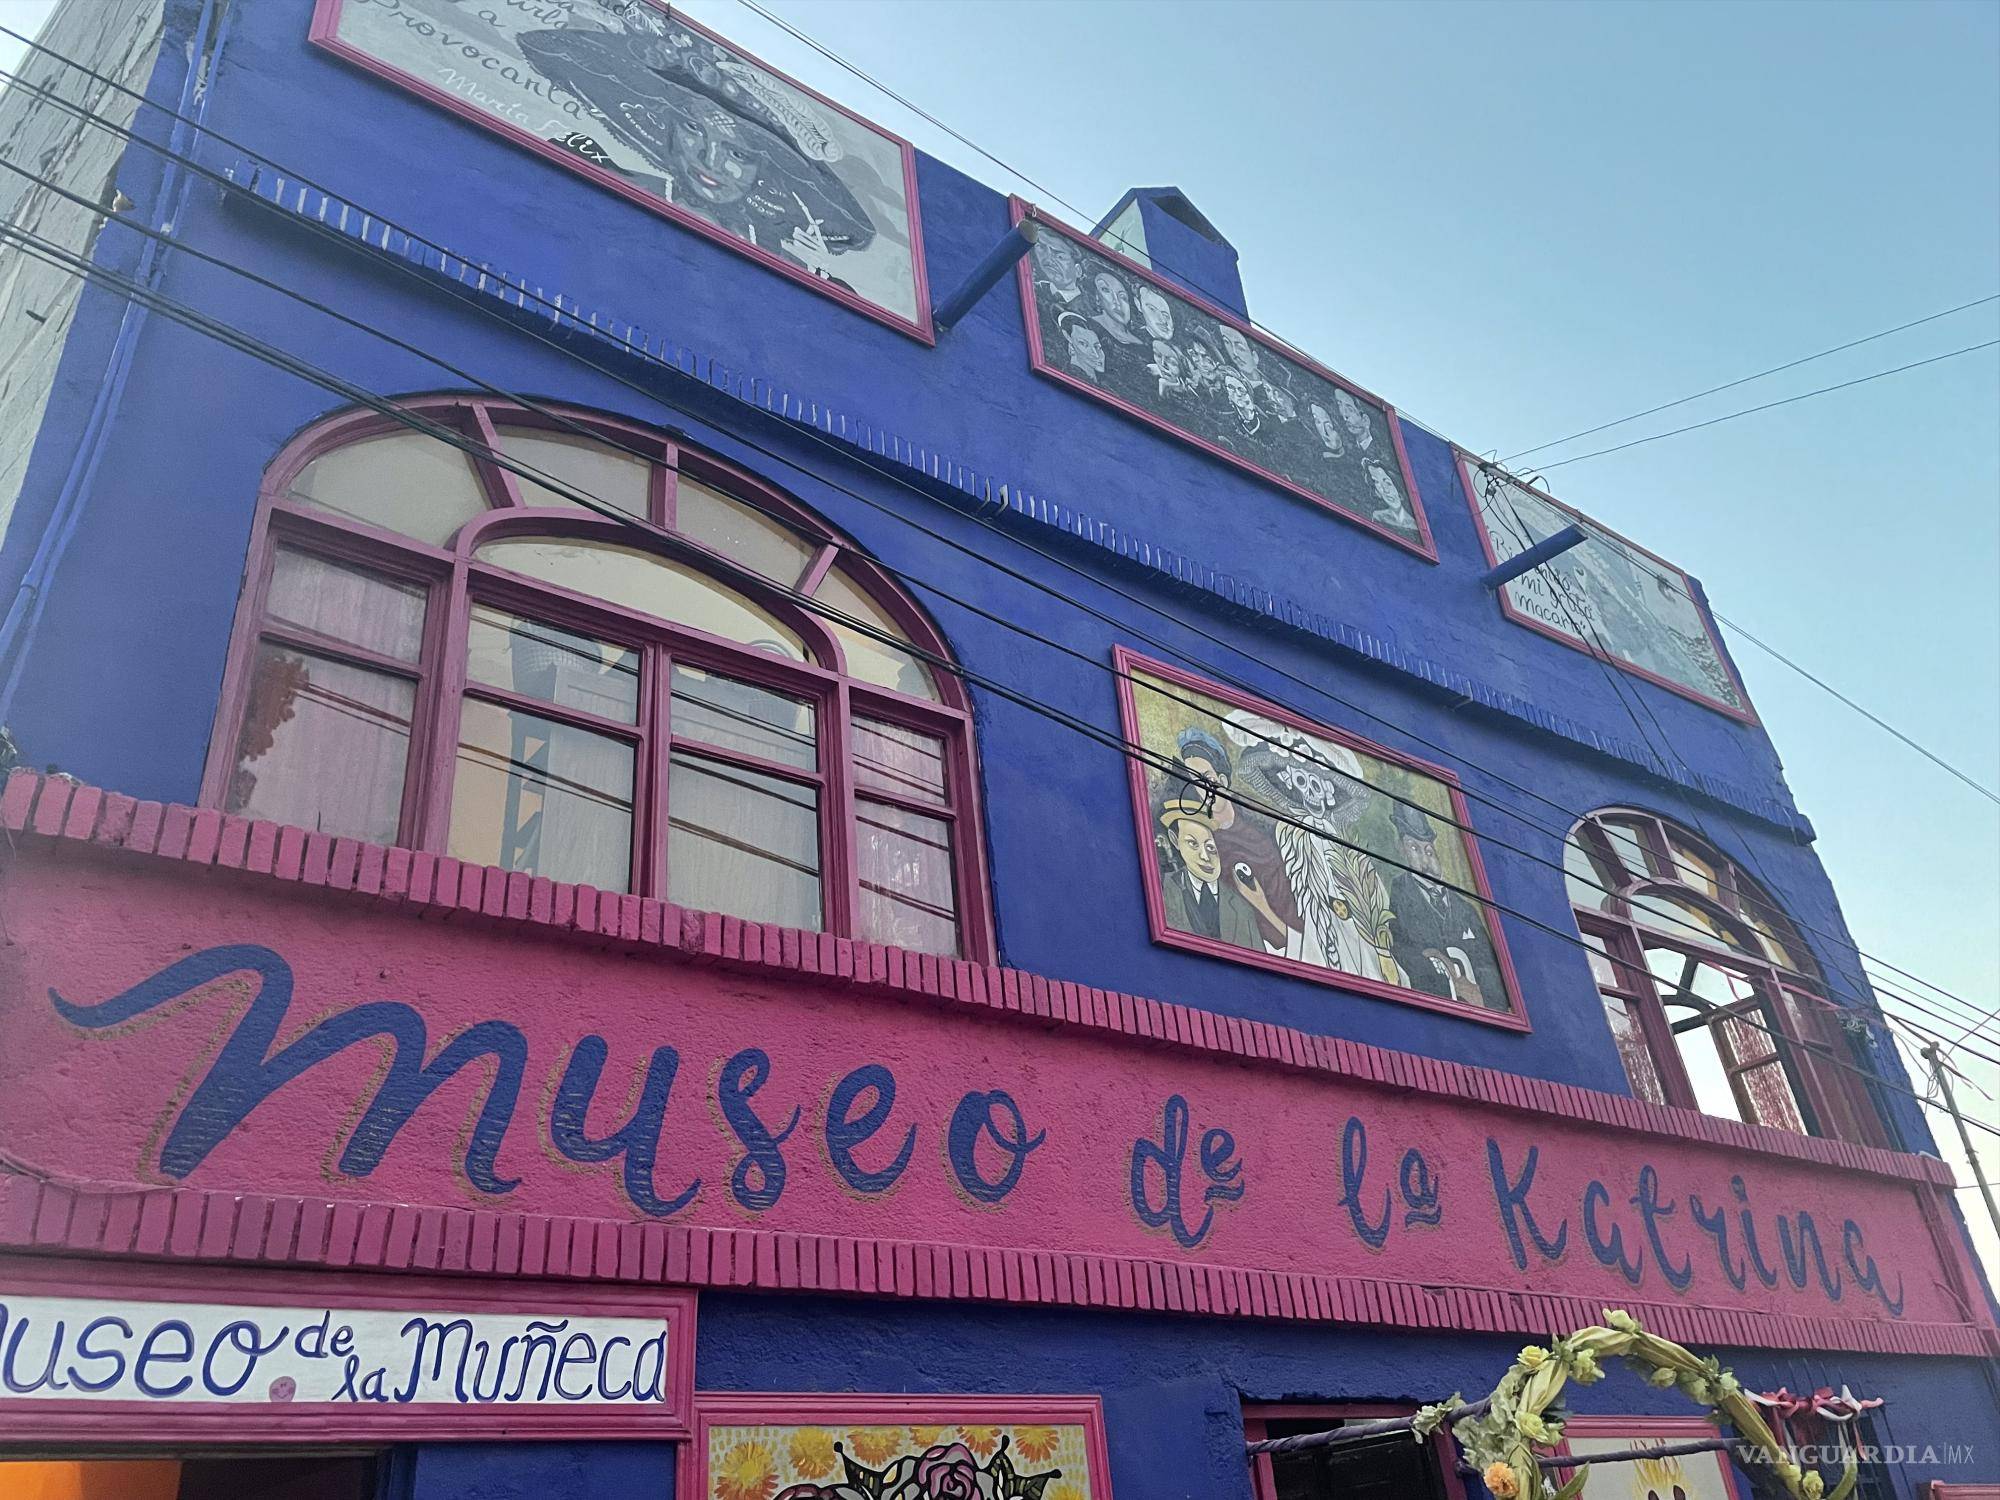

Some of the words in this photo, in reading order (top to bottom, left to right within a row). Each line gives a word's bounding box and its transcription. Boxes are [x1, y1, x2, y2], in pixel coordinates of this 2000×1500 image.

[1130, 1094, 1246, 1249] de
[1337, 1115, 1443, 1249] la
[1486, 1136, 1904, 1317] Katrina
[0, 1303, 289, 1394] useo
[295, 1310, 354, 1359] de
[331, 1354, 389, 1402] la
[394, 1317, 667, 1403] Muñeca
